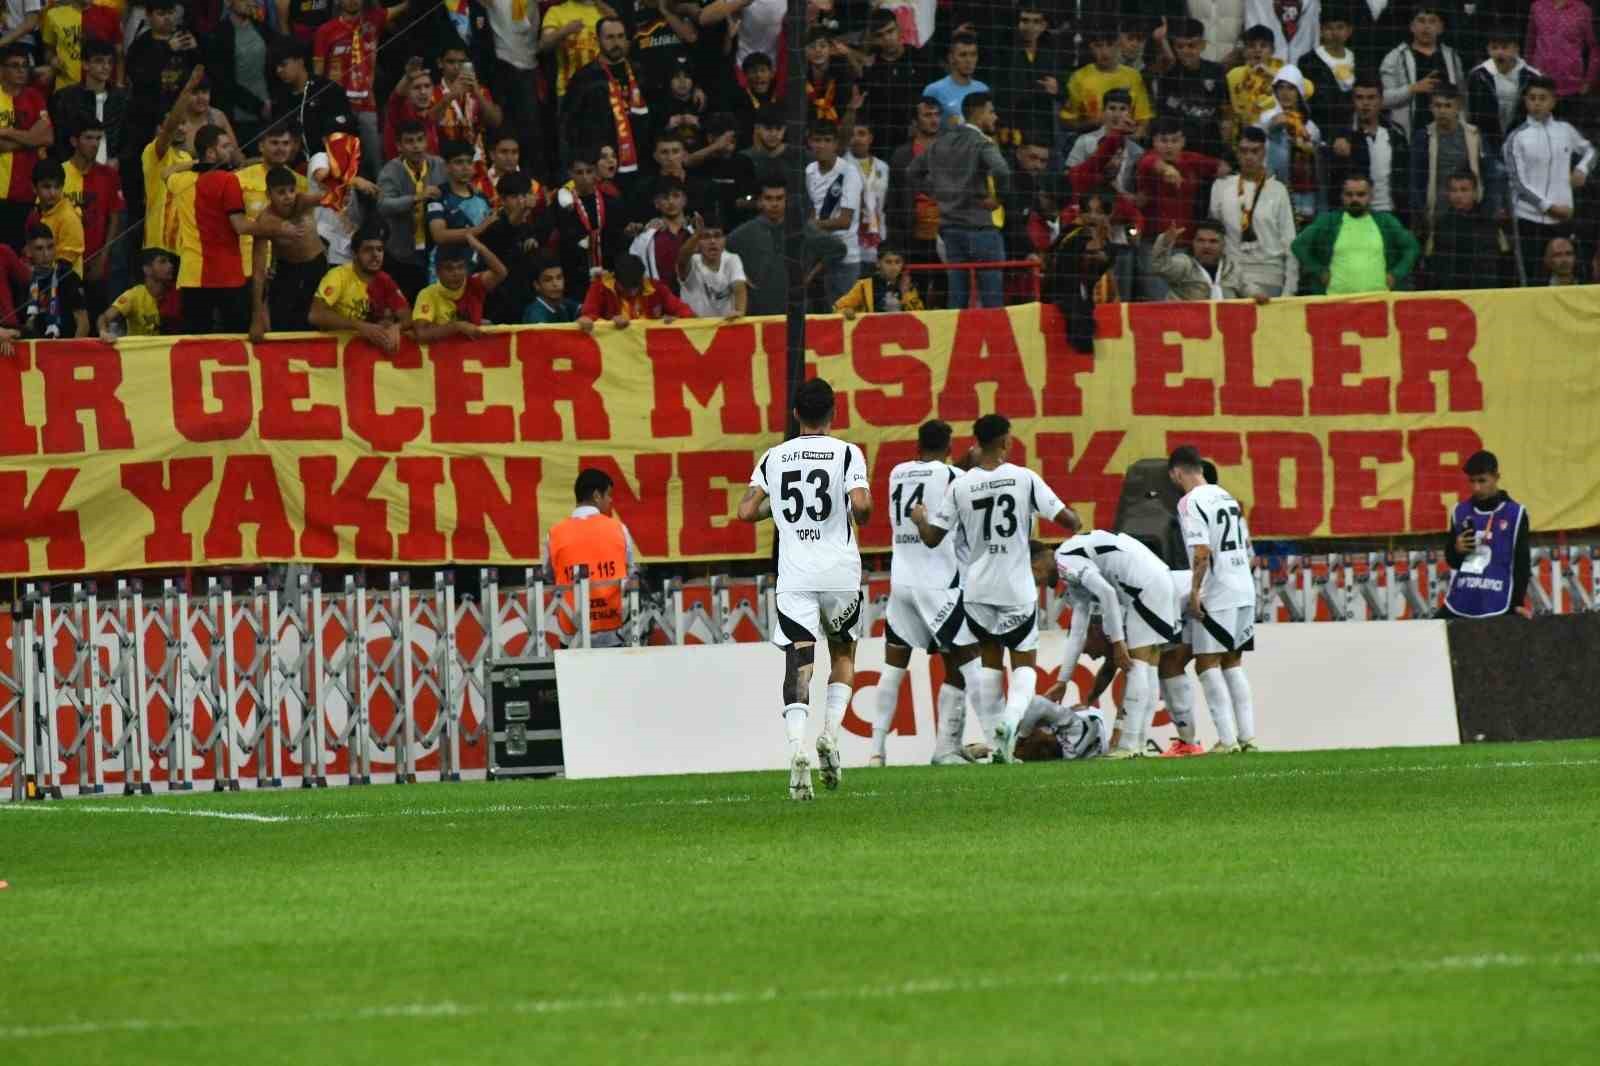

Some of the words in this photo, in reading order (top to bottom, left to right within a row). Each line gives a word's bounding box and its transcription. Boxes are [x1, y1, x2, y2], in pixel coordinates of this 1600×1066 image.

[646, 298, 1484, 438] MESAFELER
[120, 455, 542, 562] YAKIN
[580, 449, 758, 558] NE
[781, 468, 832, 523] 53
[892, 482, 926, 526] 14
[972, 493, 1018, 541] 73
[796, 528, 821, 542] TOPÇU
[1216, 506, 1242, 552] 27
[597, 560, 617, 578] 115
